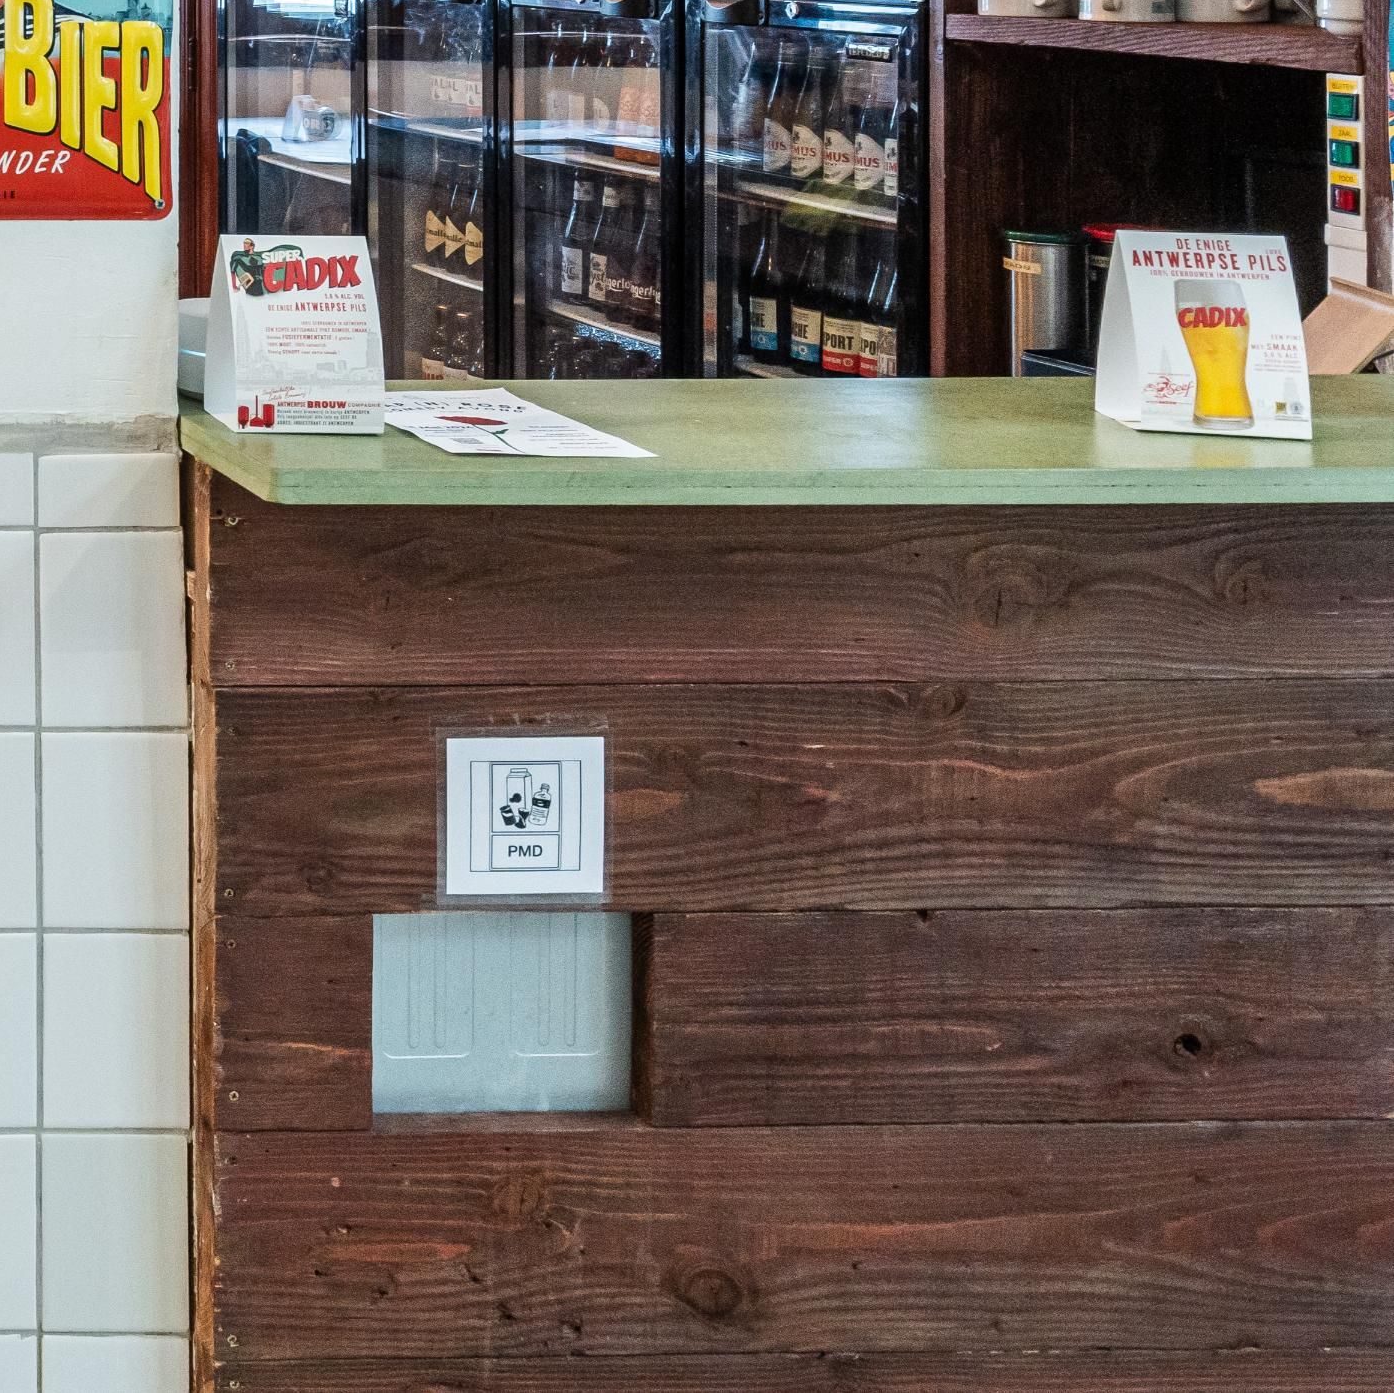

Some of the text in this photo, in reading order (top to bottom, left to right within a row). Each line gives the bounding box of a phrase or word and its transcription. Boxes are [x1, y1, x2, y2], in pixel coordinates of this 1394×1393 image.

[1175, 237, 1232, 252] DE ENIGE
[262, 249, 304, 264] SUPER
[1132, 249, 1288, 272] ANTWERPSE PILS
[263, 254, 362, 294] CADIX
[1170, 269, 1214, 278] GEBROUWEN
[1226, 272, 1270, 280] ANTWERPEN
[295, 302, 347, 312] ANTWERPSE
[350, 304, 367, 312] PILS
[1178, 306, 1248, 329] CADIX
[823, 332, 855, 351] PORT
[307, 400, 347, 409] BROUW
[507, 844, 544, 858] PMD
